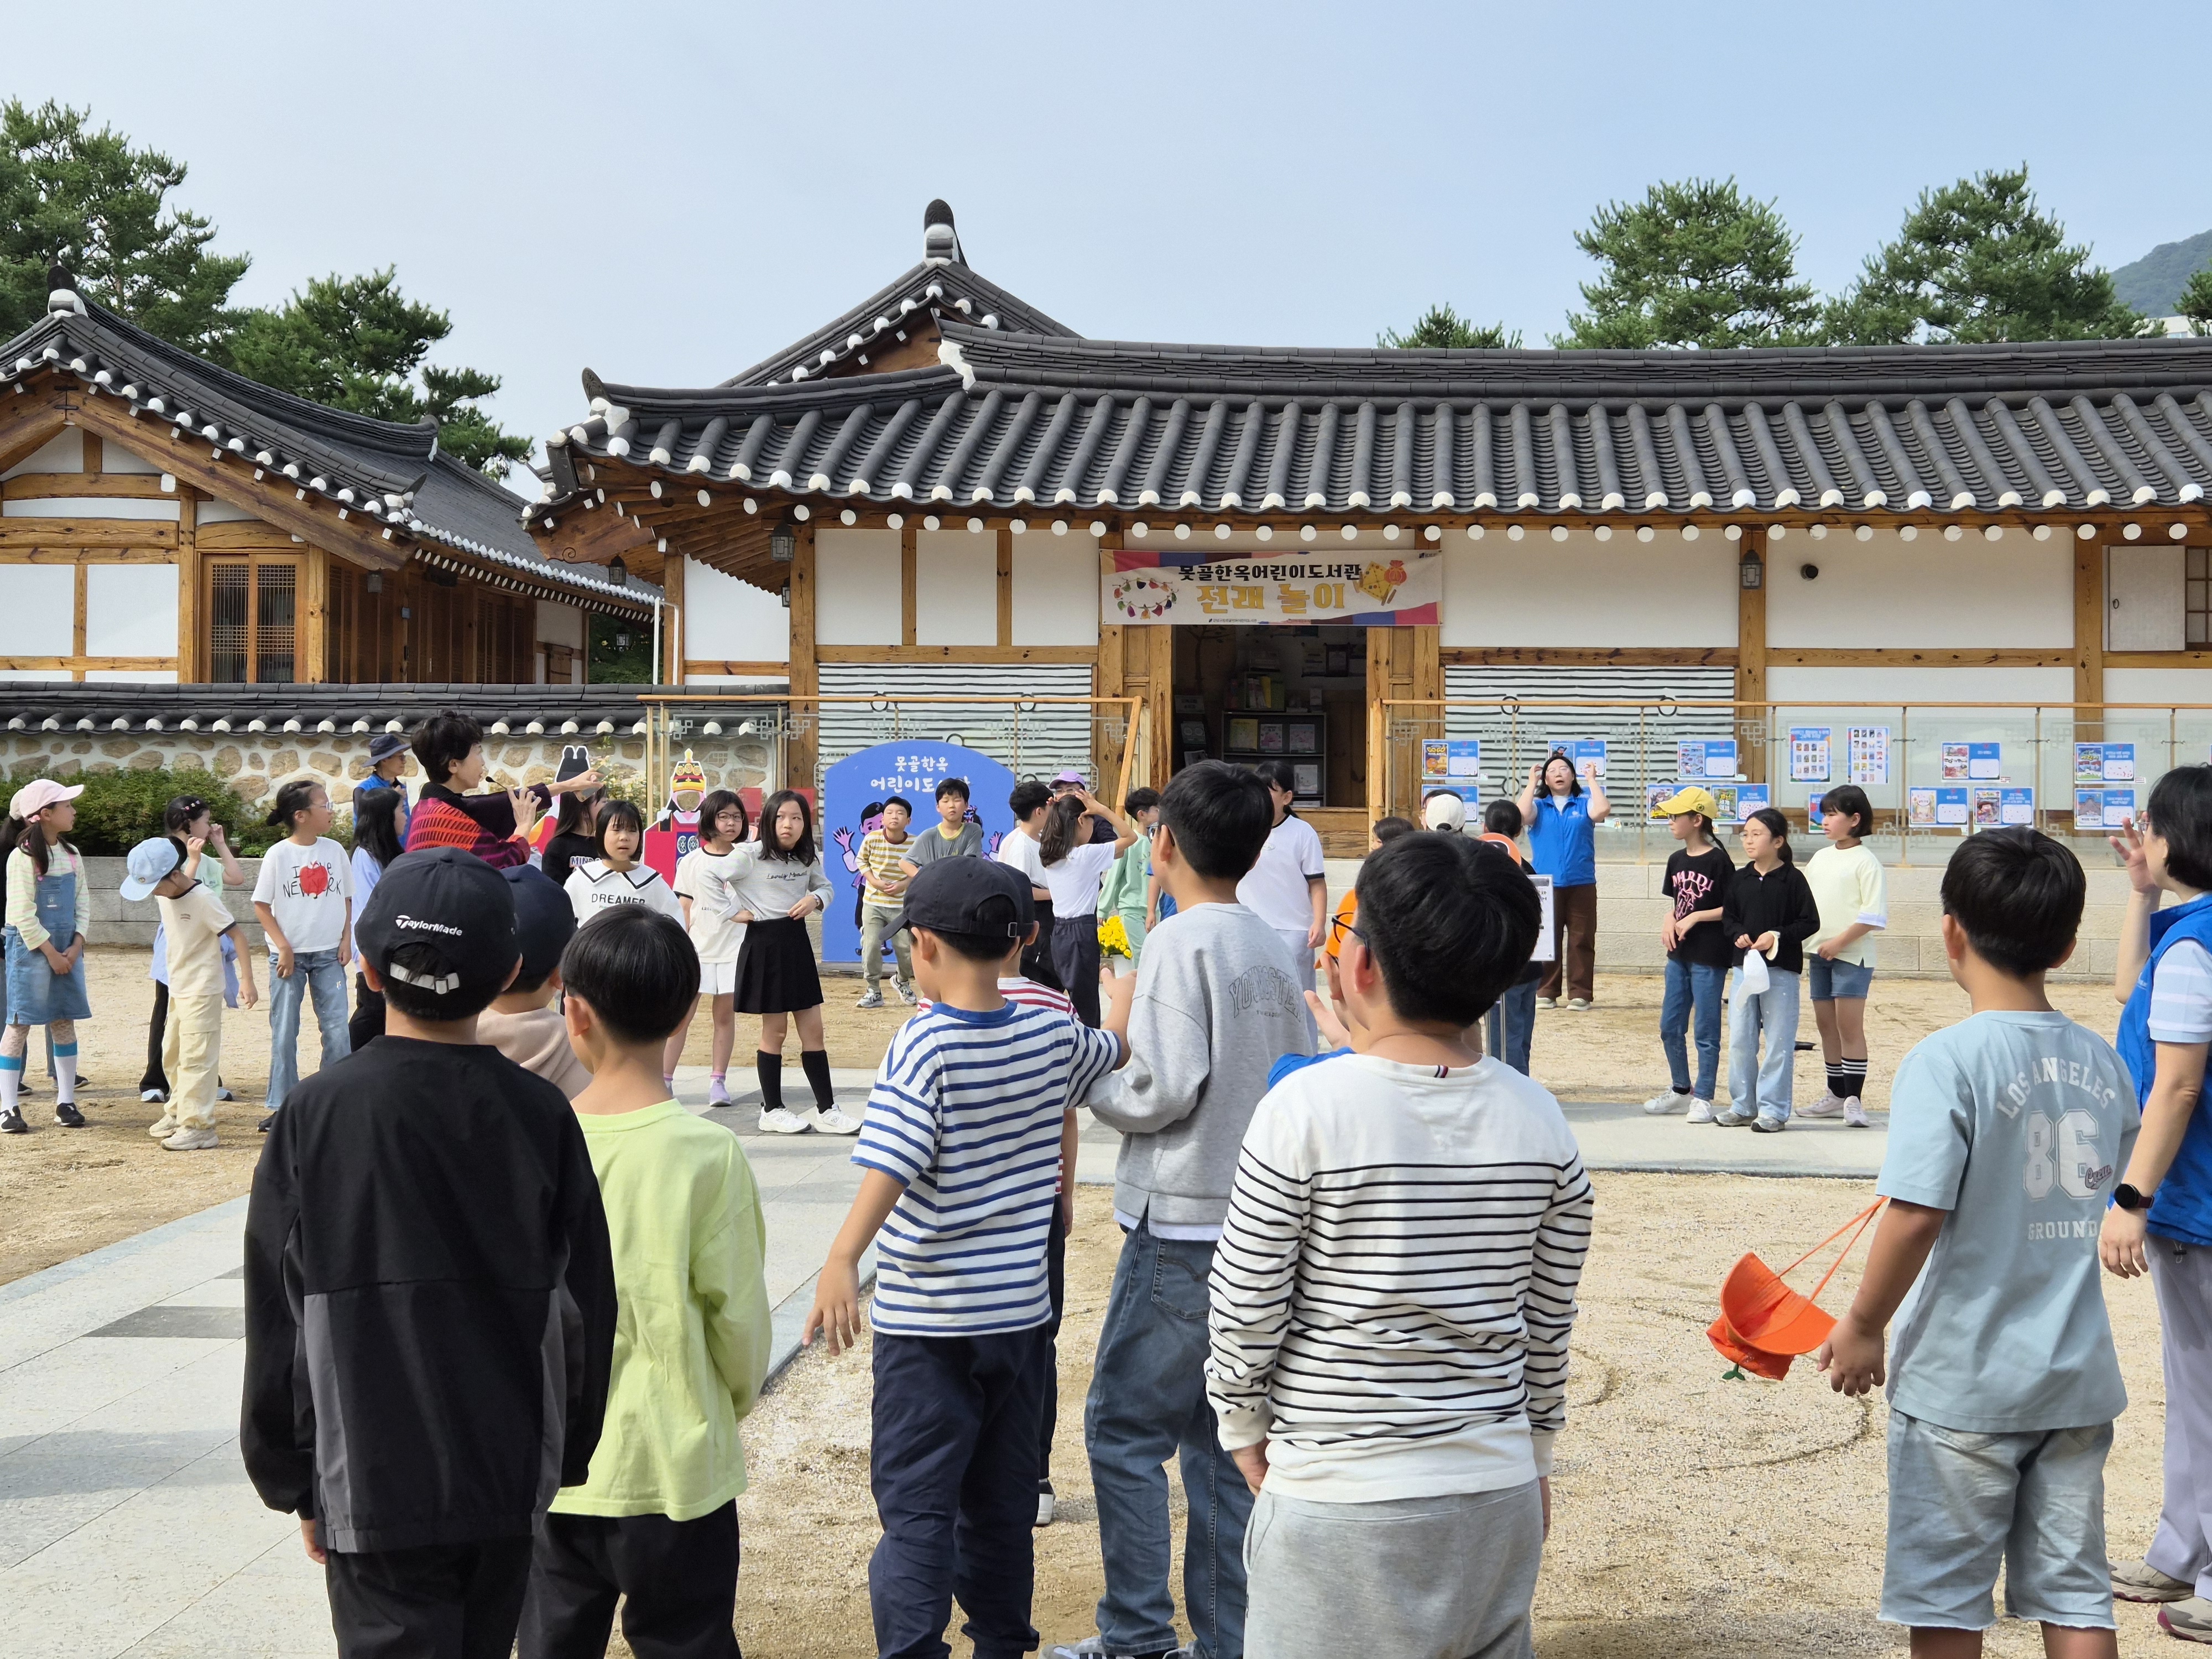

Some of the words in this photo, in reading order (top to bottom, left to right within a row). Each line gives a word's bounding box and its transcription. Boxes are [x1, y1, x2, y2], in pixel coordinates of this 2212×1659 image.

[1178, 564, 1362, 581] 못골한옥어린이도서관
[1196, 585, 1265, 614] 전래
[1277, 583, 1345, 614] 놀이
[895, 755, 948, 773] 못골한옥
[870, 775, 971, 793] 어린이도
[291, 865, 300, 878] I
[1671, 870, 1714, 892] MARDI
[591, 893, 645, 905] DREAMER
[395, 915, 463, 936] TaylorMade
[1996, 1071, 2031, 1119] LOS
[2031, 1057, 2115, 1109] ANGELES
[2023, 1108, 2101, 1202] 86
[2028, 1220, 2098, 1240] GROUND
